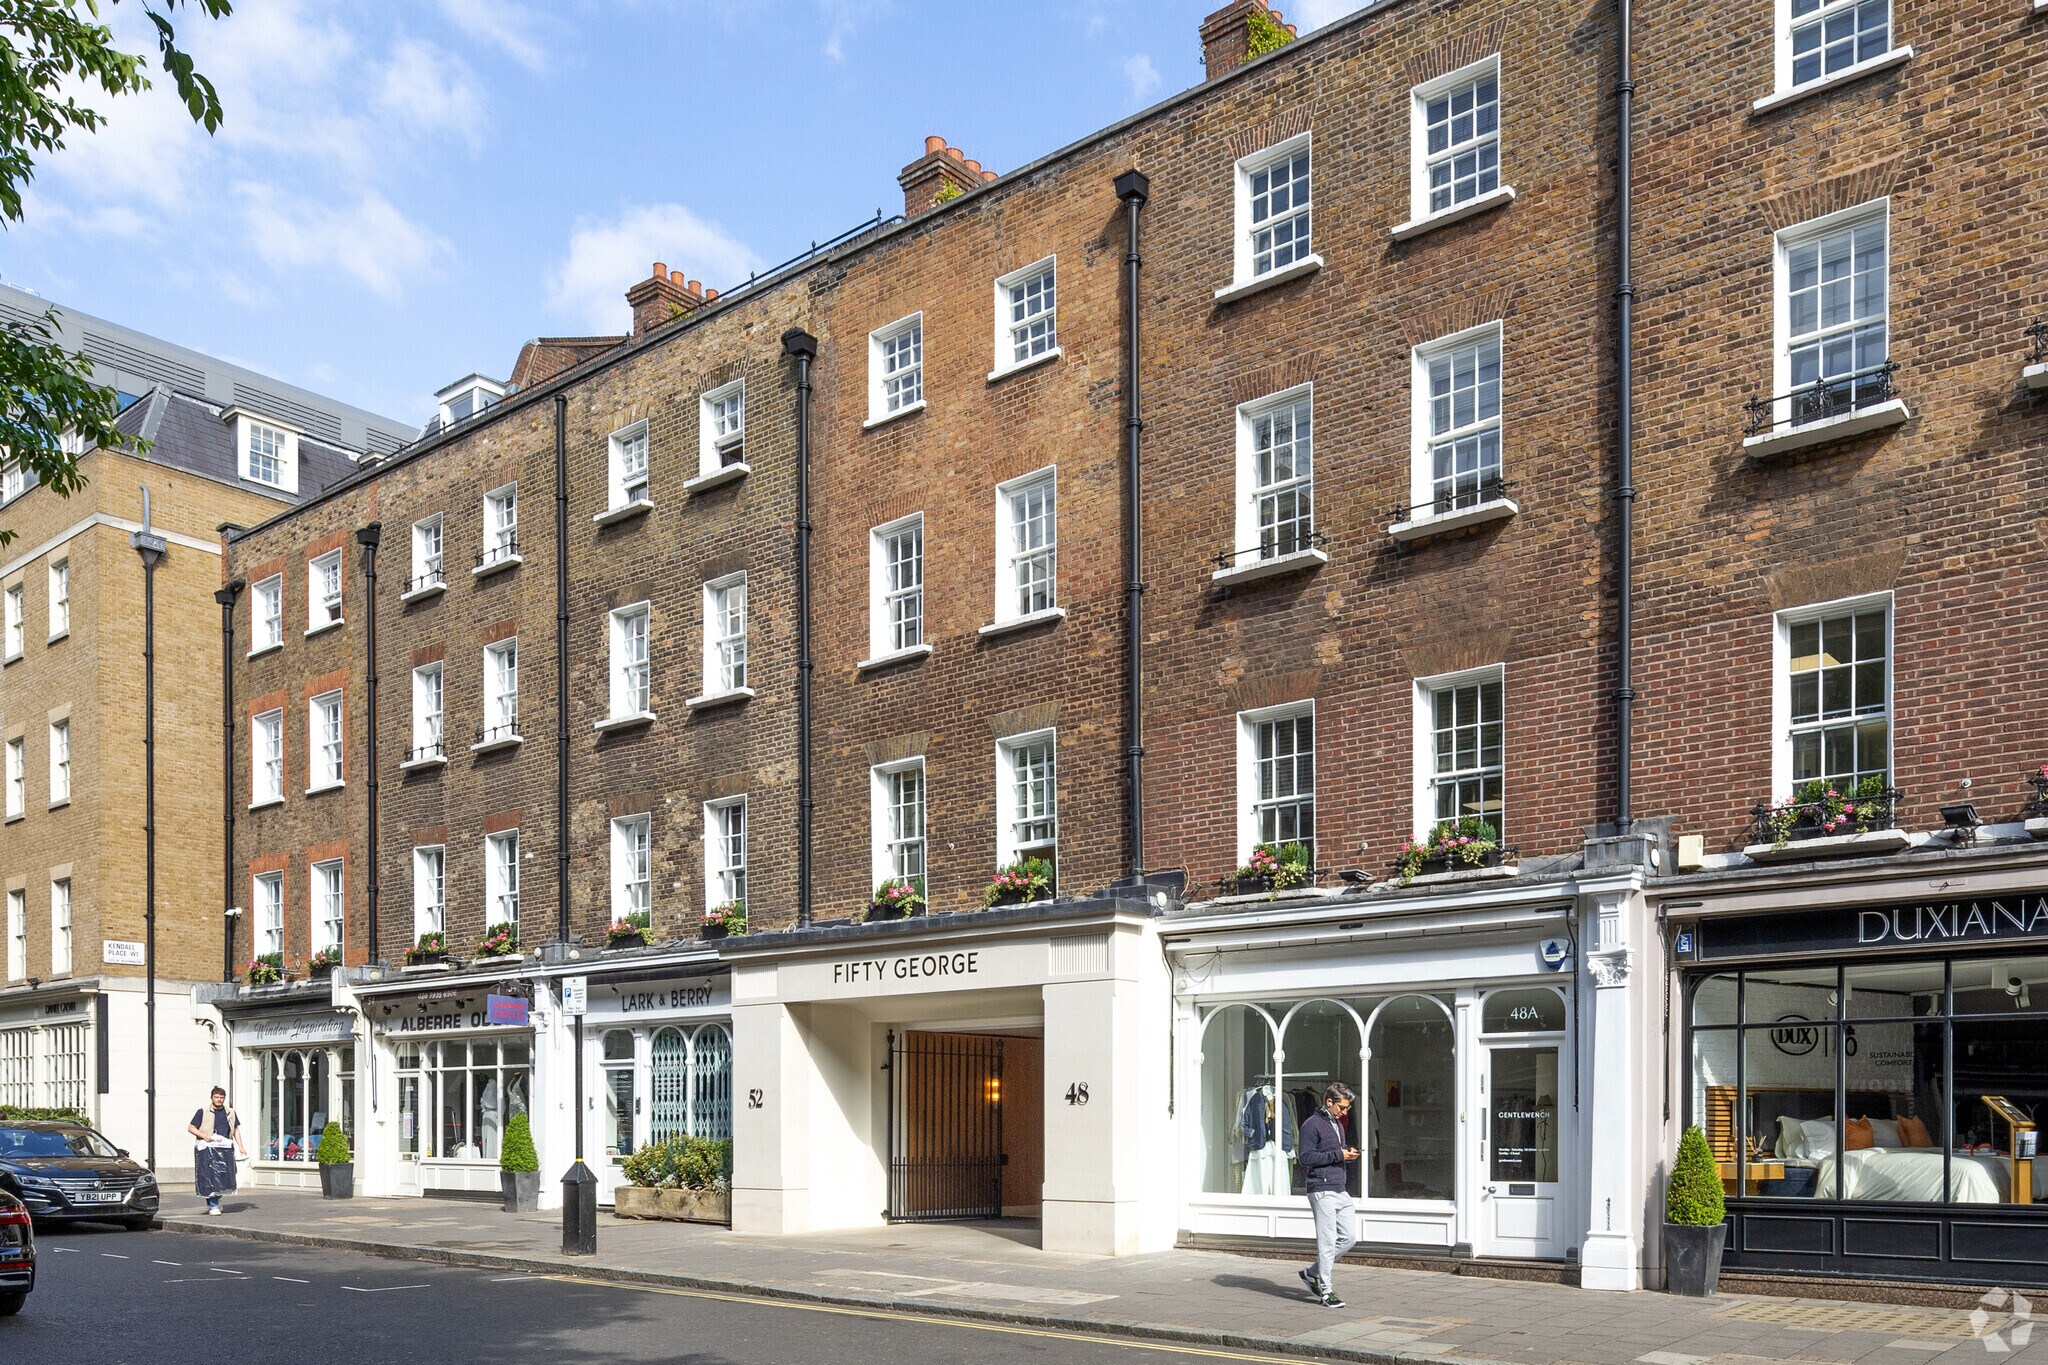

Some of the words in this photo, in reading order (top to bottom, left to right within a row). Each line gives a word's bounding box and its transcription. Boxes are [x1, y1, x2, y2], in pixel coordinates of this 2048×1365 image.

[1858, 897, 2048, 943] DUXIANA
[108, 943, 135, 951] KENDALL
[1680, 934, 1689, 951] ADT
[834, 960, 887, 984] FIFTY
[894, 952, 978, 979] GEORGE
[622, 992, 655, 1012] LARK
[658, 994, 666, 1006] &
[671, 987, 713, 1007] BERRY
[1510, 1006, 1539, 1020] 48A
[254, 1021, 290, 1040] Window
[290, 1017, 344, 1040] Inspiration
[401, 1014, 462, 1032] ALBERRE
[1778, 1028, 1813, 1045] DUX
[1869, 1051, 1914, 1059] SUSTAINABL
[1875, 1059, 1913, 1067] COMFORT
[748, 1088, 763, 1110] 52
[1064, 1081, 1089, 1106] 48
[1498, 1111, 1550, 1119] GENTLEWENCH
[80, 1193, 99, 1201] YB21
[100, 1193, 117, 1201] UPP
